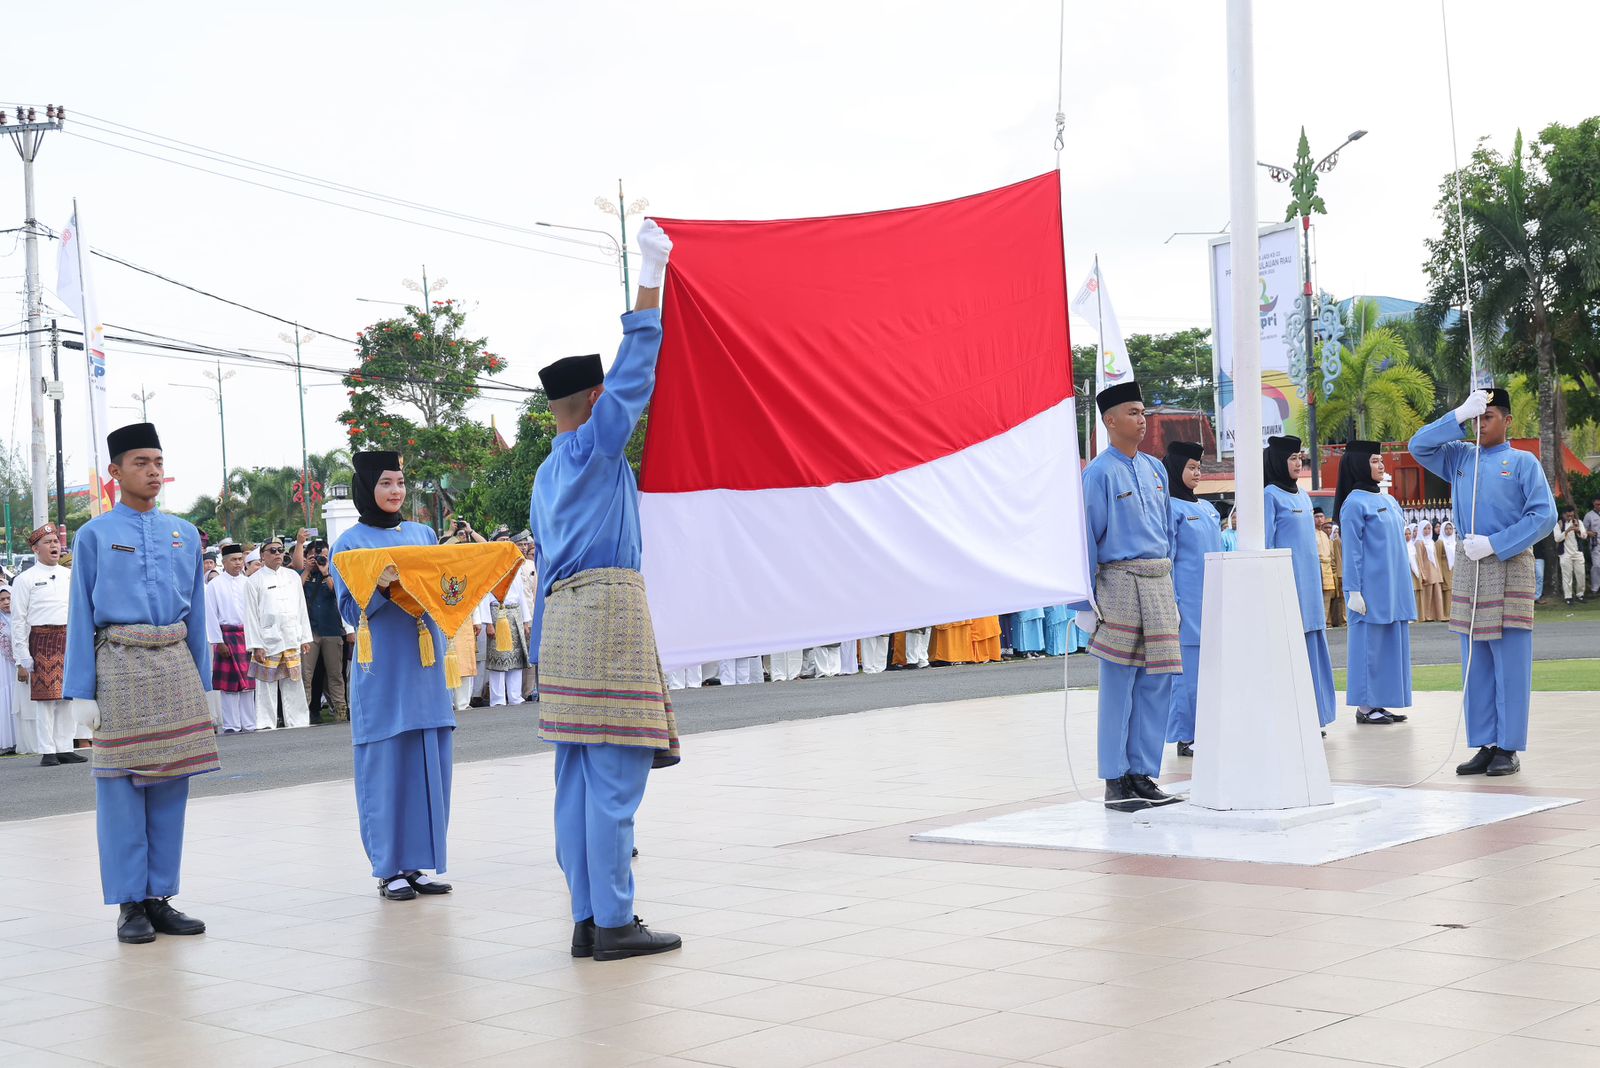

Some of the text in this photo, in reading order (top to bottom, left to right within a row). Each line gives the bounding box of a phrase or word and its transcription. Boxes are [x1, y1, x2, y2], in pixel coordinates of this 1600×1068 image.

[1259, 256, 1291, 270] ULAUAN RIAU
[1261, 313, 1277, 329] pri
[1262, 425, 1282, 435] TIAWAN
